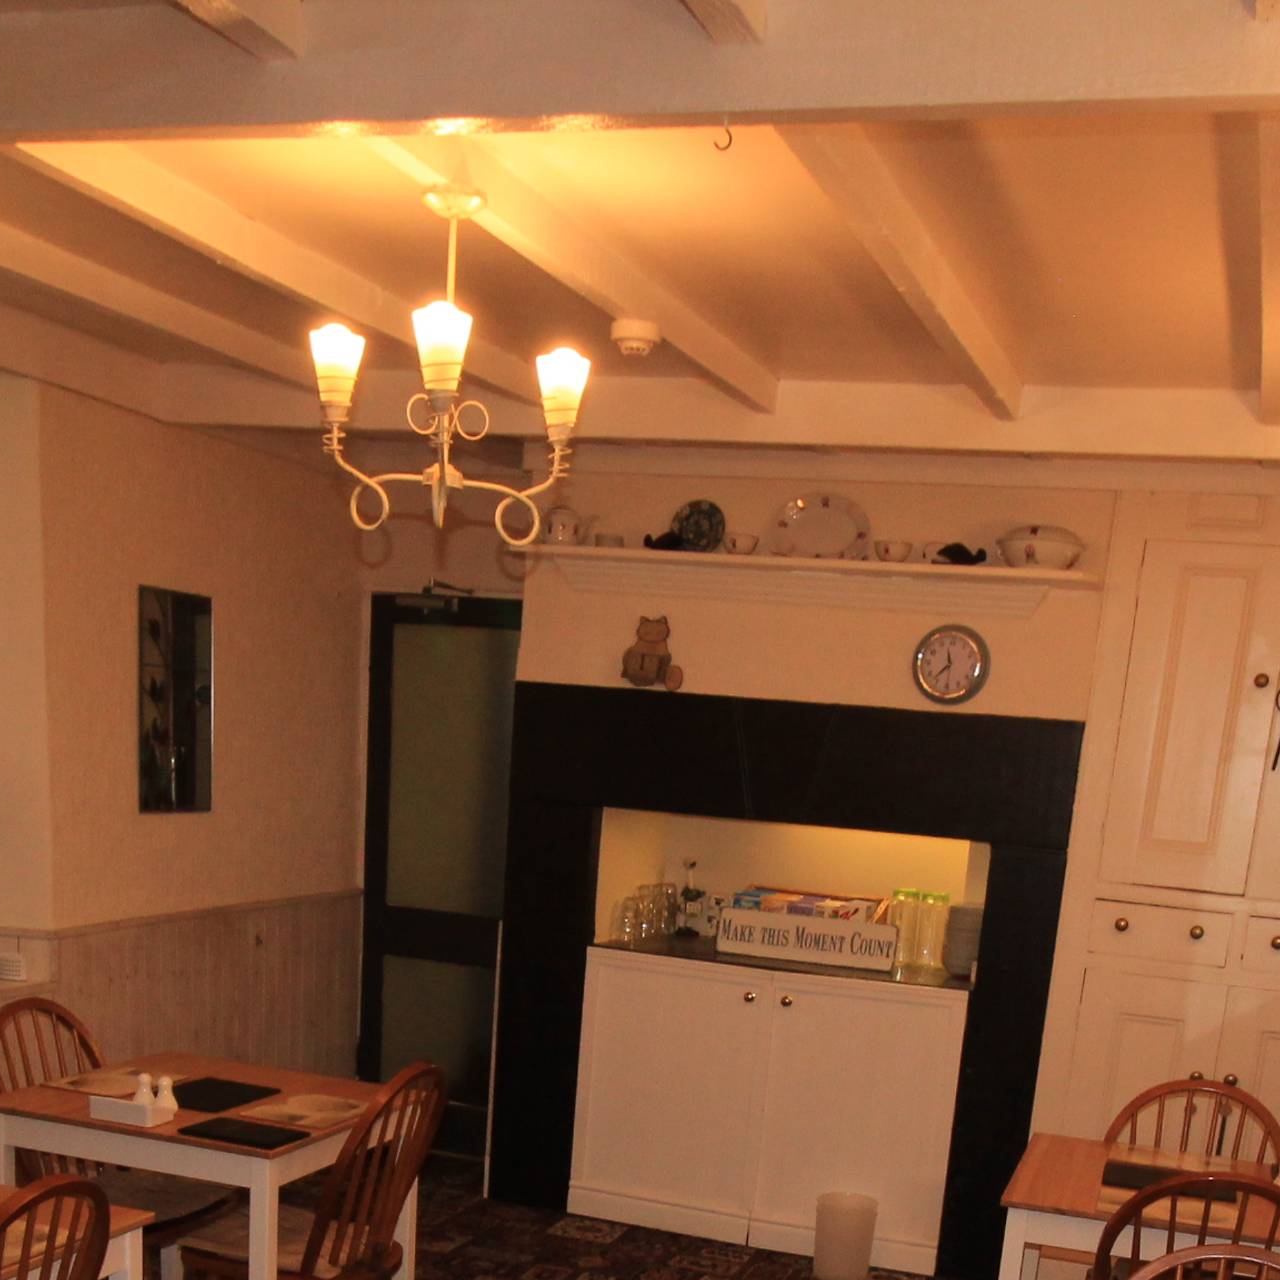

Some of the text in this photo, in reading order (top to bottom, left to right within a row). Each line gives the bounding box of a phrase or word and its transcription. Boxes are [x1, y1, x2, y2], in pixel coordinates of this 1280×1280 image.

[720, 917, 894, 959] MAKE THIS MOMENT COUNT
